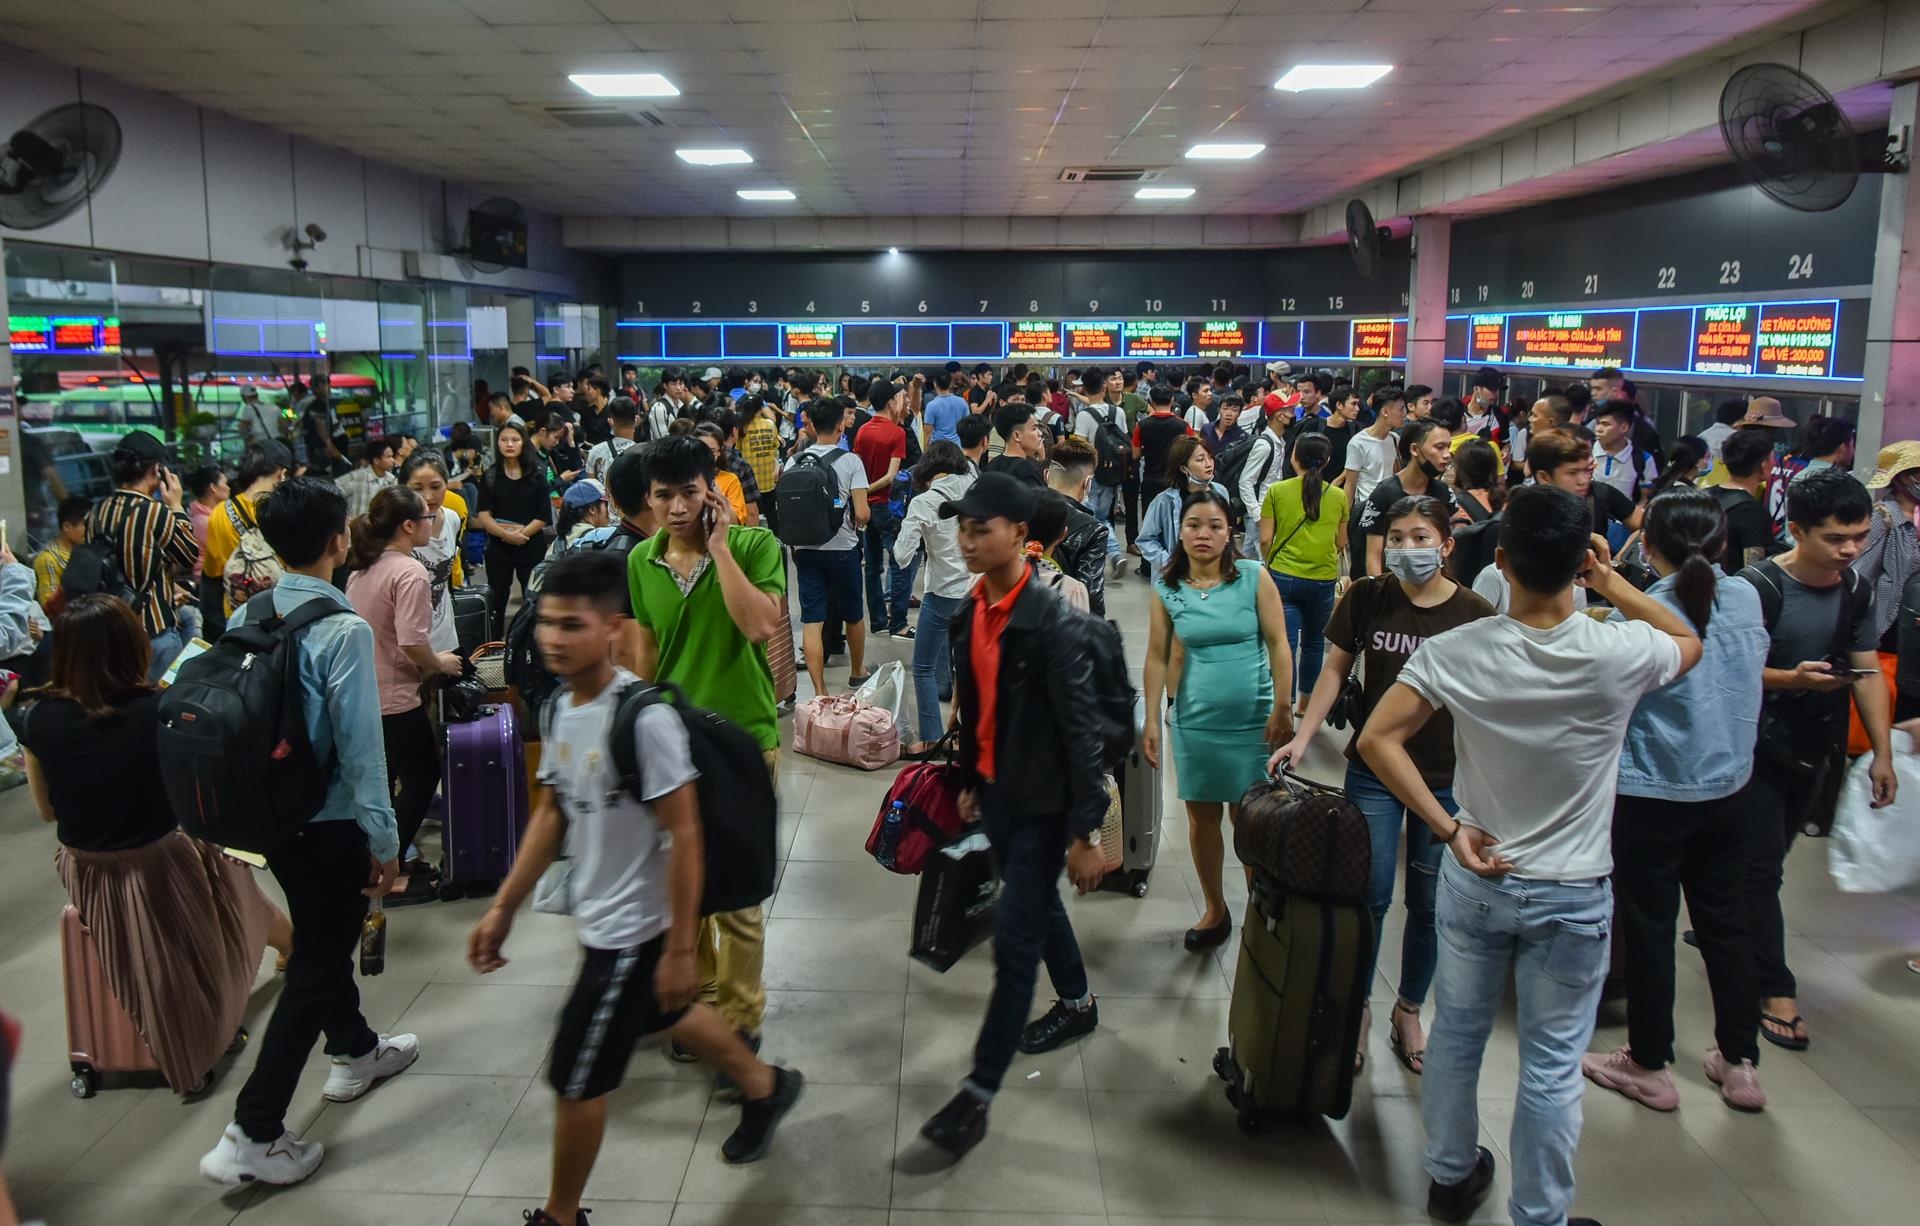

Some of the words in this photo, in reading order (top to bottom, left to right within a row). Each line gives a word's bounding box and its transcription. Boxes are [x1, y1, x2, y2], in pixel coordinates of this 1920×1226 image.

[1719, 261, 1741, 284] 23
[1788, 254, 1814, 279] 24
[1658, 267, 1677, 289] 22
[1521, 281, 1534, 298] 20
[1584, 275, 1598, 295] 21
[1451, 289, 1460, 303] 18
[1478, 286, 1488, 301] 19
[1029, 300, 1039, 312] 8
[1089, 300, 1099, 312] 9
[1144, 300, 1162, 312] 10
[1211, 299, 1227, 311] 11
[1281, 299, 1295, 311] 12
[1328, 297, 1344, 310] 15
[1401, 293, 1409, 307] 16
[637, 301, 644, 313] 1
[692, 301, 701, 313] 2
[748, 301, 757, 313] 3
[806, 301, 816, 313] 4
[861, 301, 870, 313] 5
[918, 301, 928, 313] 6
[979, 301, 988, 312] 7
[1705, 306, 1729, 320] PHÚC
[1730, 306, 1747, 323] LỢI
[1760, 319, 1772, 331] XE
[1773, 316, 1796, 331] TĂNG
[1796, 316, 1832, 331] CƯỜNG
[1363, 335, 1386, 345] Friday
[1548, 330, 1556, 341] TP
[1726, 334, 1735, 344] TP
[1770, 333, 1790, 346] VINH
[1761, 346, 1776, 360] GIÁ
